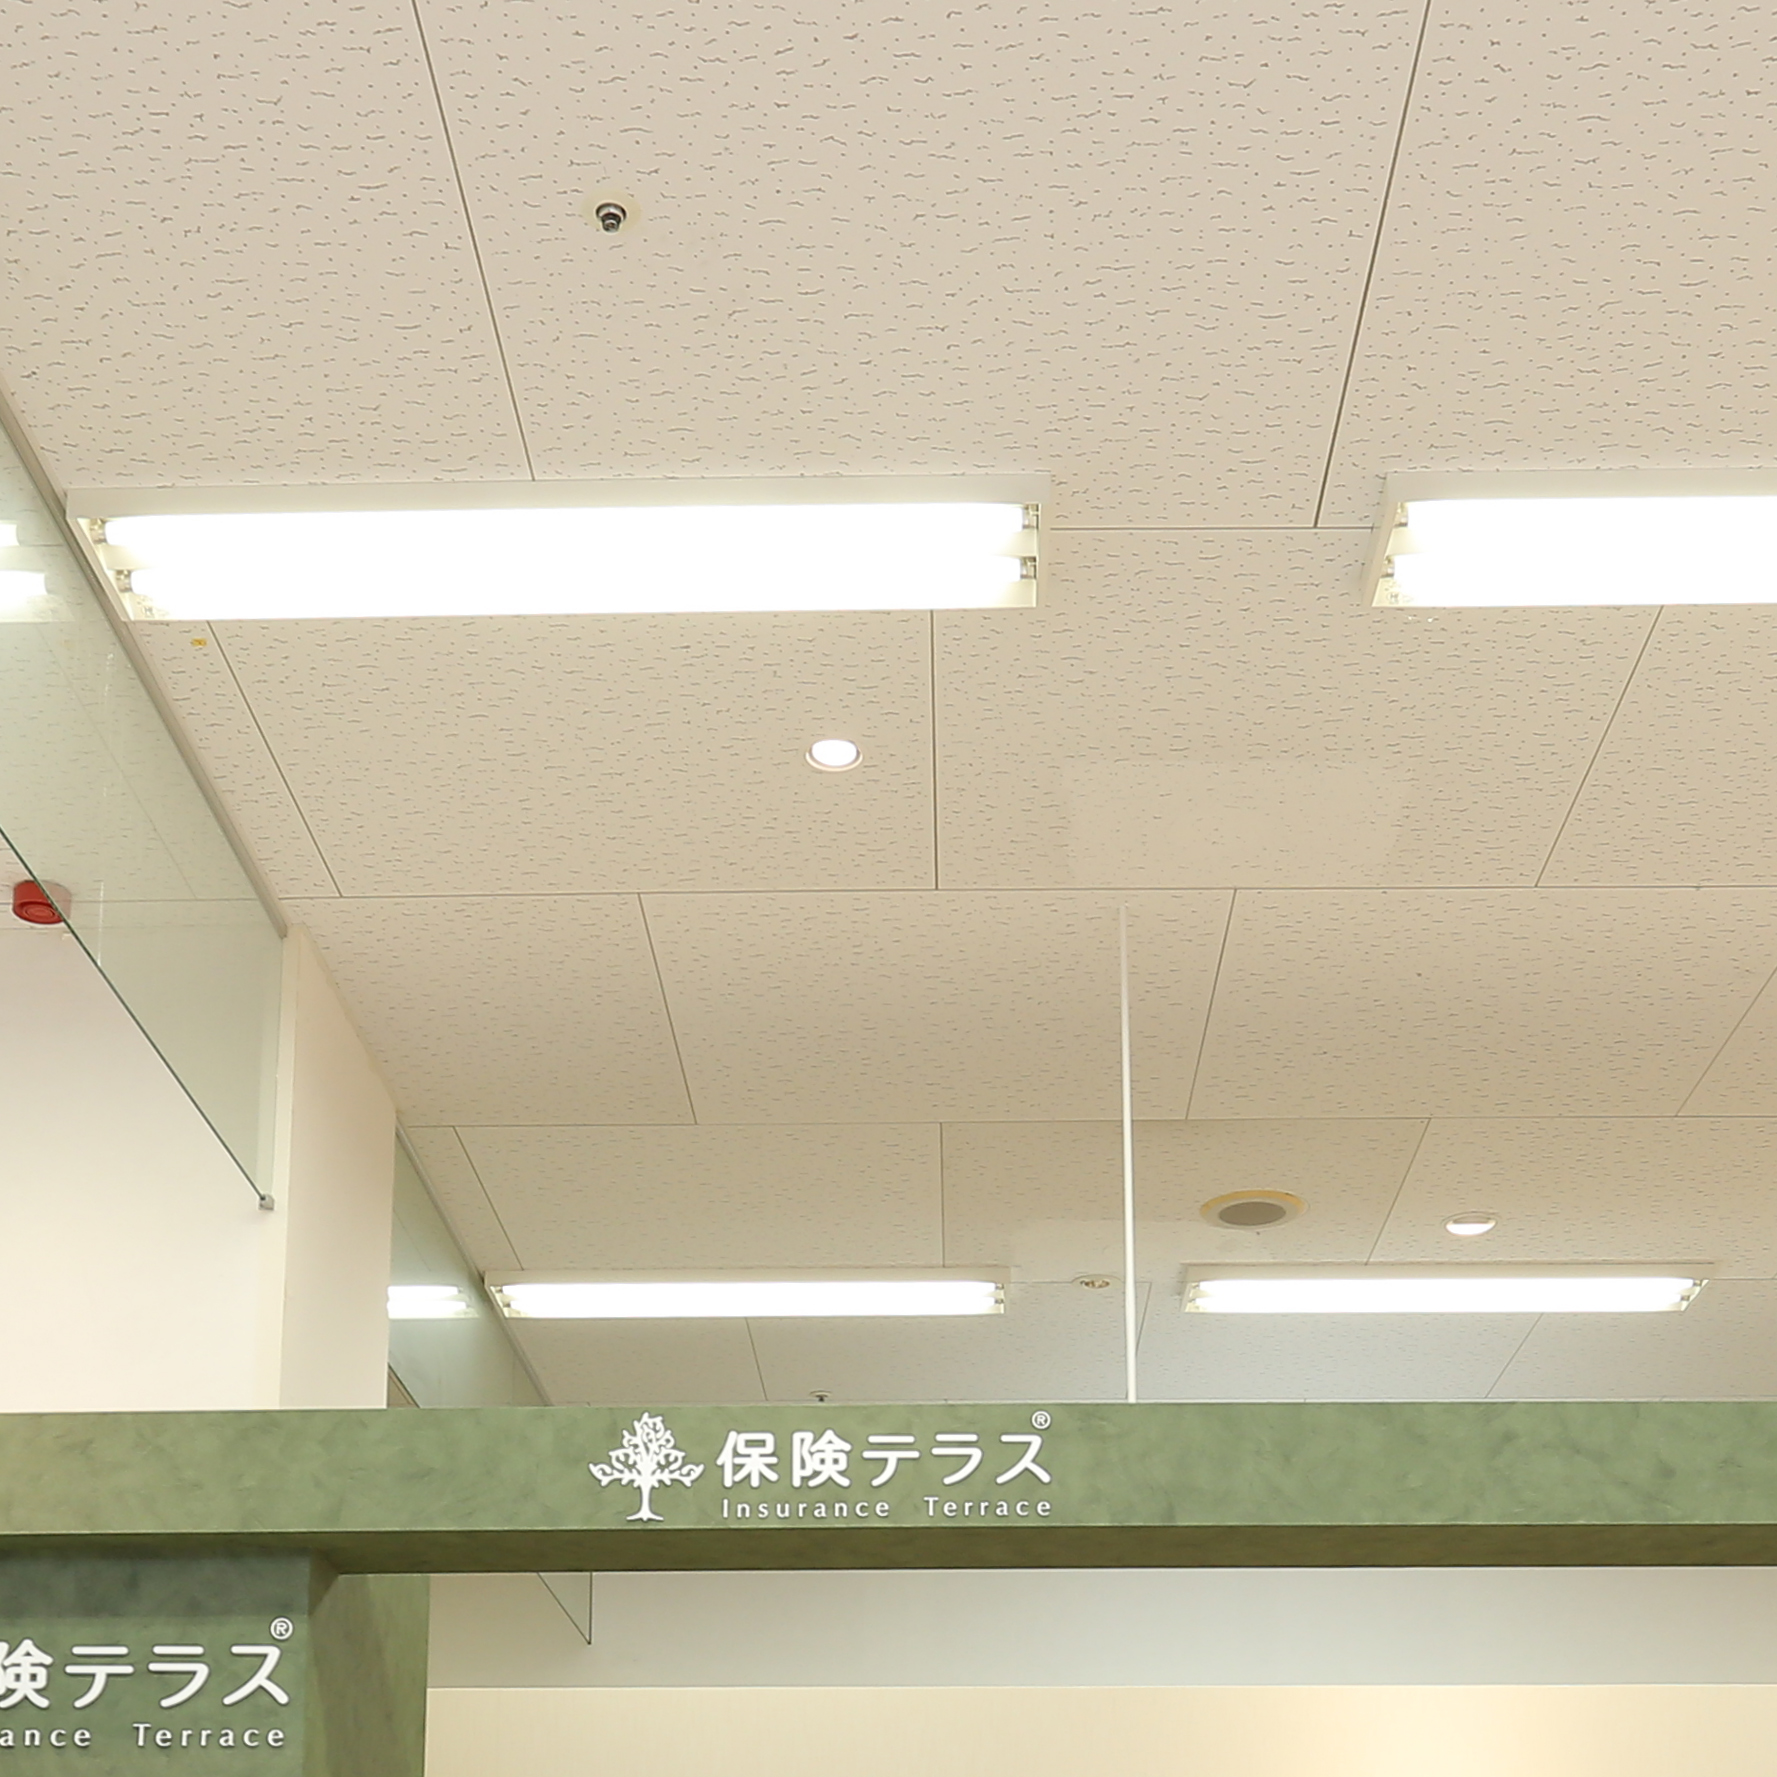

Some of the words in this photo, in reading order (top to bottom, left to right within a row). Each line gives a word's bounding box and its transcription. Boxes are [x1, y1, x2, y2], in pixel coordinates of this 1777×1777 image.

[717, 1428, 1053, 1489] 保険テラス
[722, 1497, 891, 1519] Insurance
[924, 1496, 1053, 1518] Terrace
[133, 1722, 286, 1748] Terrace
